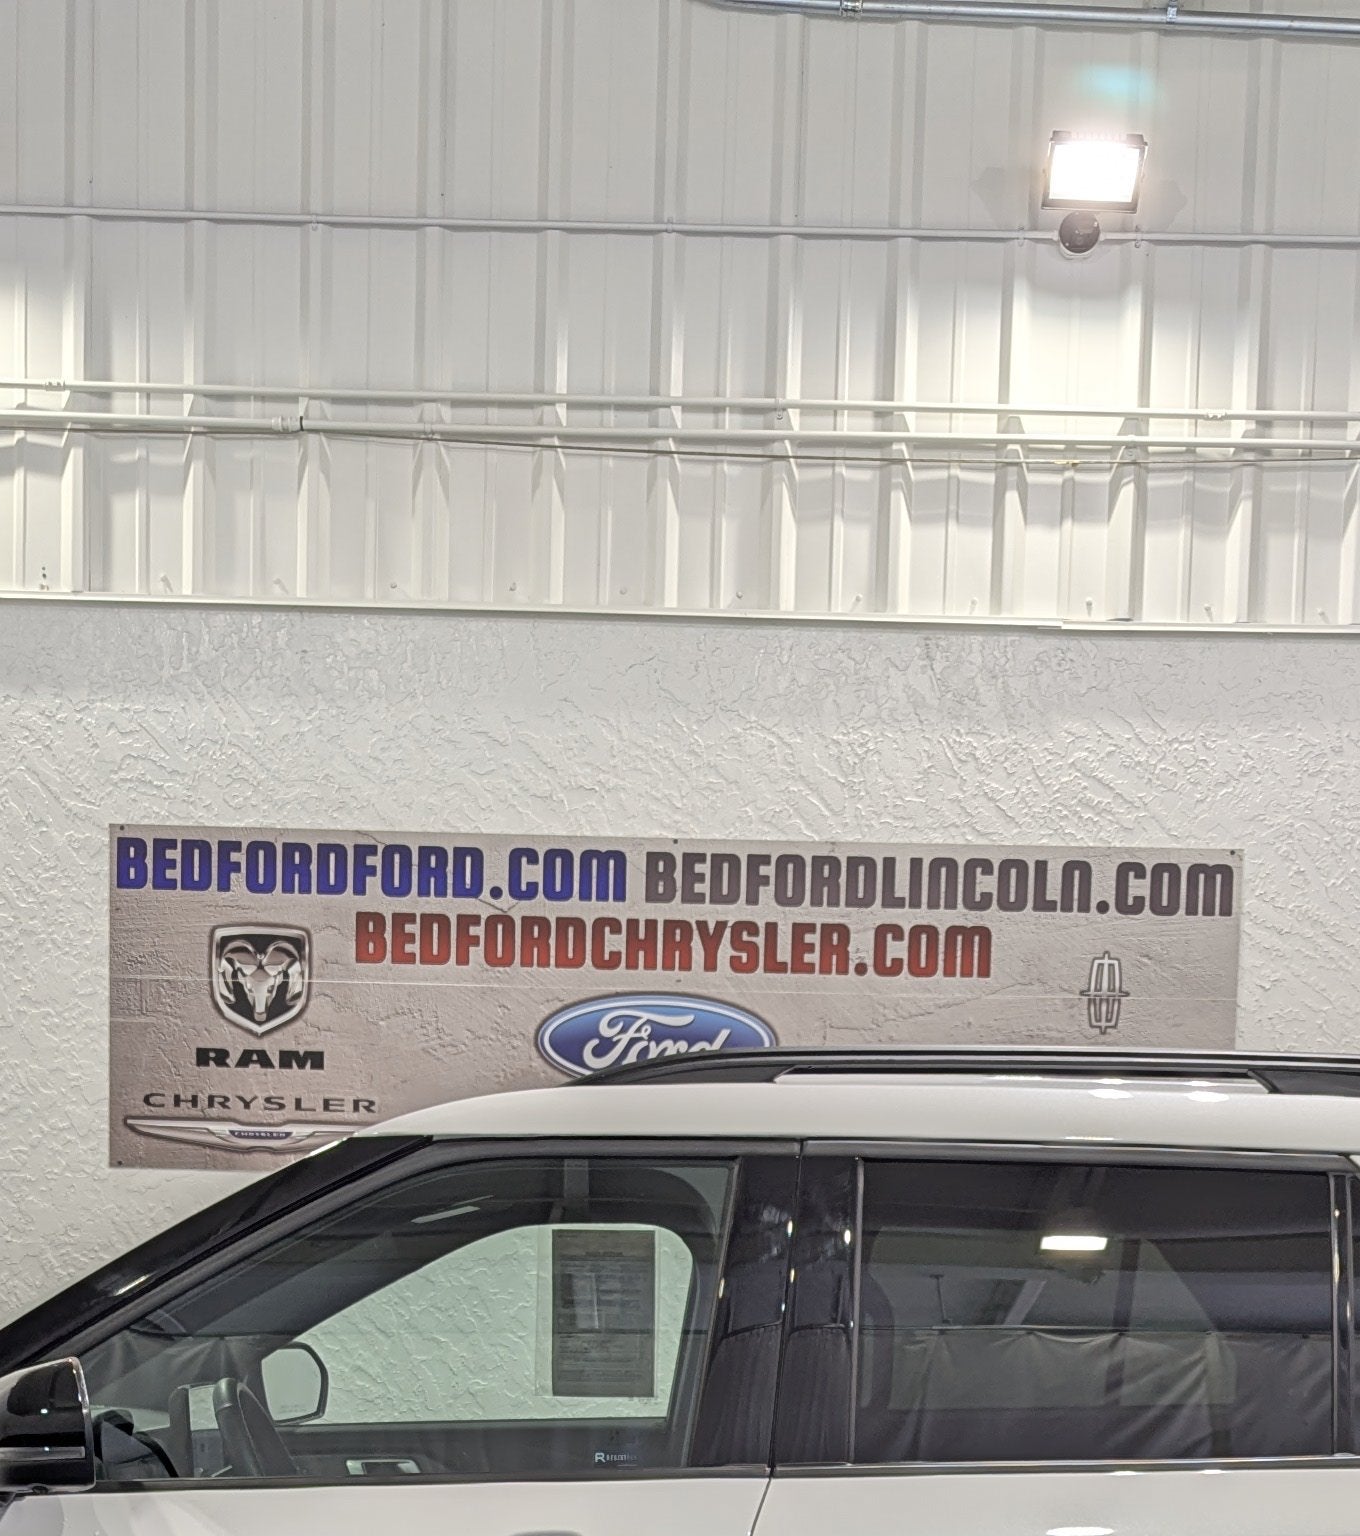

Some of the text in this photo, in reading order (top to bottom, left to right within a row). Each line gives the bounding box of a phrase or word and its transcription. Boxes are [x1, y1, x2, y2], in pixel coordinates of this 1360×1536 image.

[115, 836, 1234, 918] BEDFORDFORD.COM BEDFORDLINCOLN.COM
[354, 910, 993, 979] BEDFORDCHRYSLER.COM
[195, 1046, 325, 1071] RAM
[142, 1092, 377, 1114] CHRYSLER
